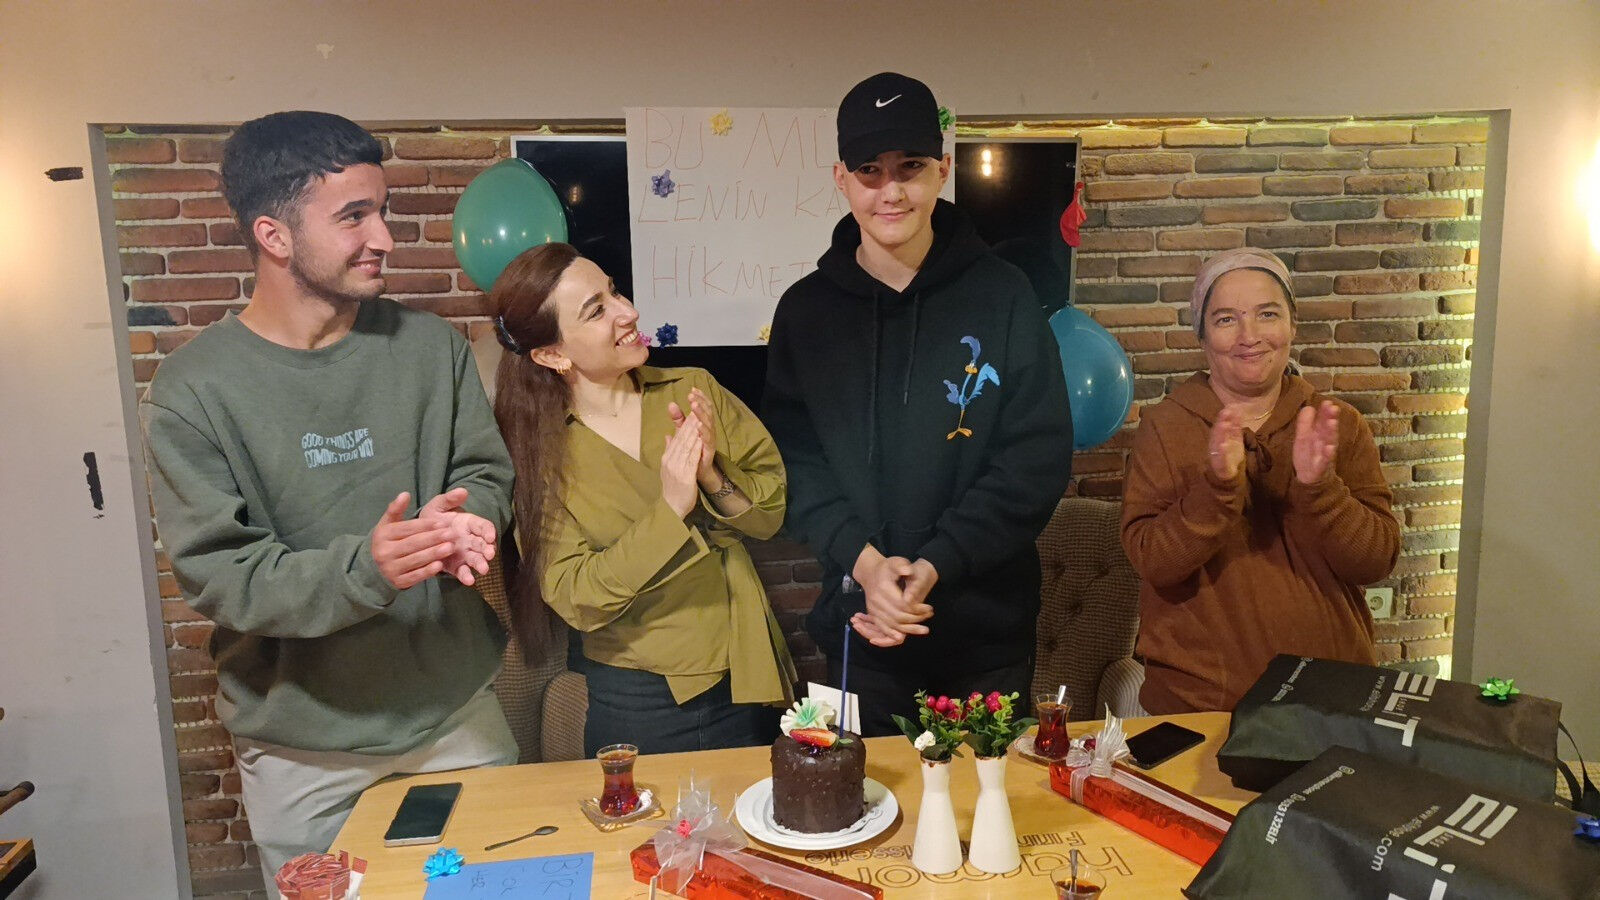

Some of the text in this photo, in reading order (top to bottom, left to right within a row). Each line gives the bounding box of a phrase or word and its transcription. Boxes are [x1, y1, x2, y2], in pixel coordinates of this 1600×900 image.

[645, 107, 704, 170] BU
[794, 174, 844, 219] KA
[302, 428, 369, 449] GOOD THINGS ARE
[304, 437, 375, 468] COMING YOUR WAY
